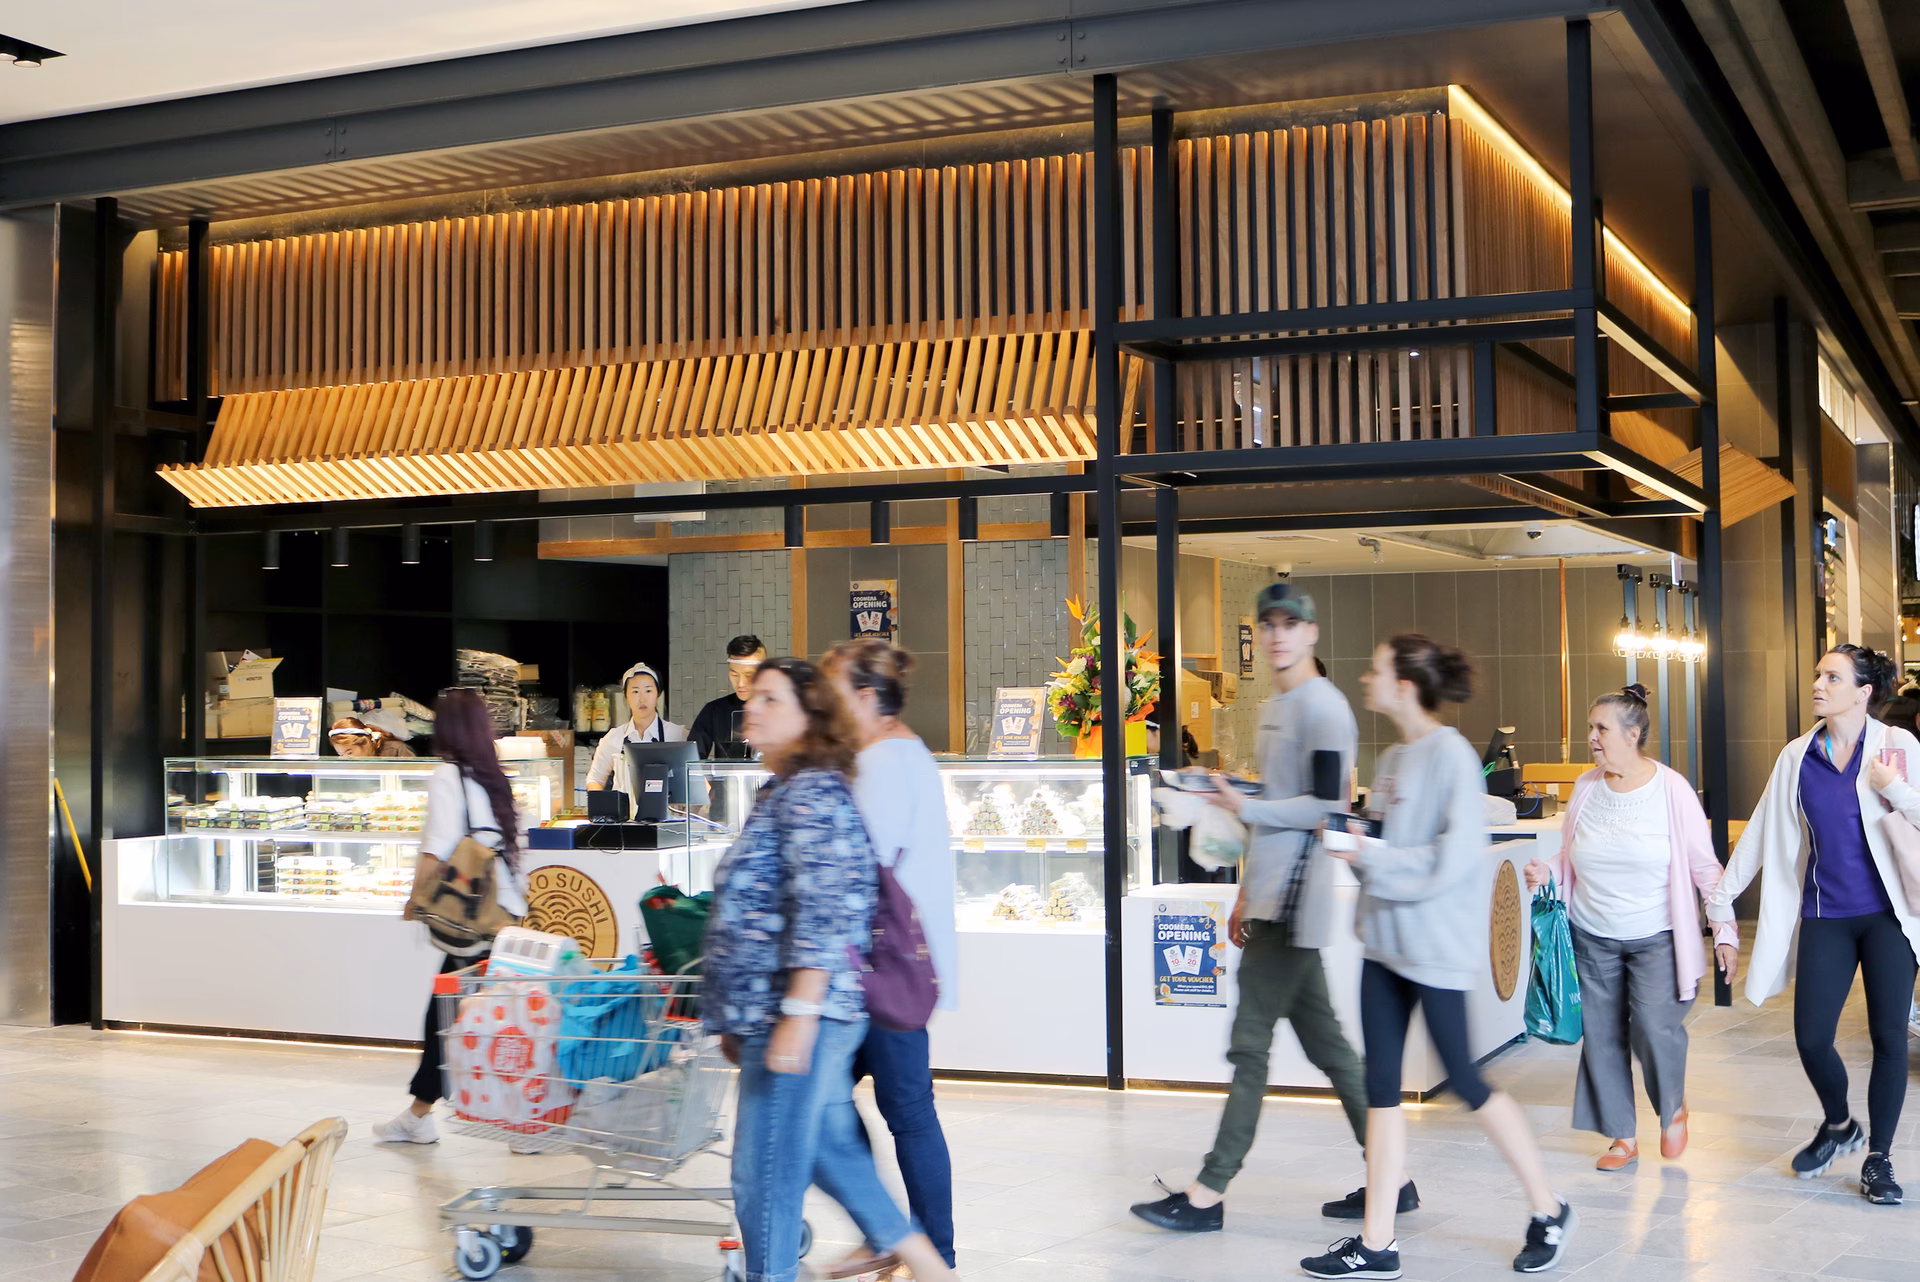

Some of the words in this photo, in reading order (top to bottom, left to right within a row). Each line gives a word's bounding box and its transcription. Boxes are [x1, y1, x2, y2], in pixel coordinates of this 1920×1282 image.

[556, 873, 608, 923] SUSHI
[1158, 923, 1195, 931] COOMERA
[1158, 931, 1210, 941] OPENING
